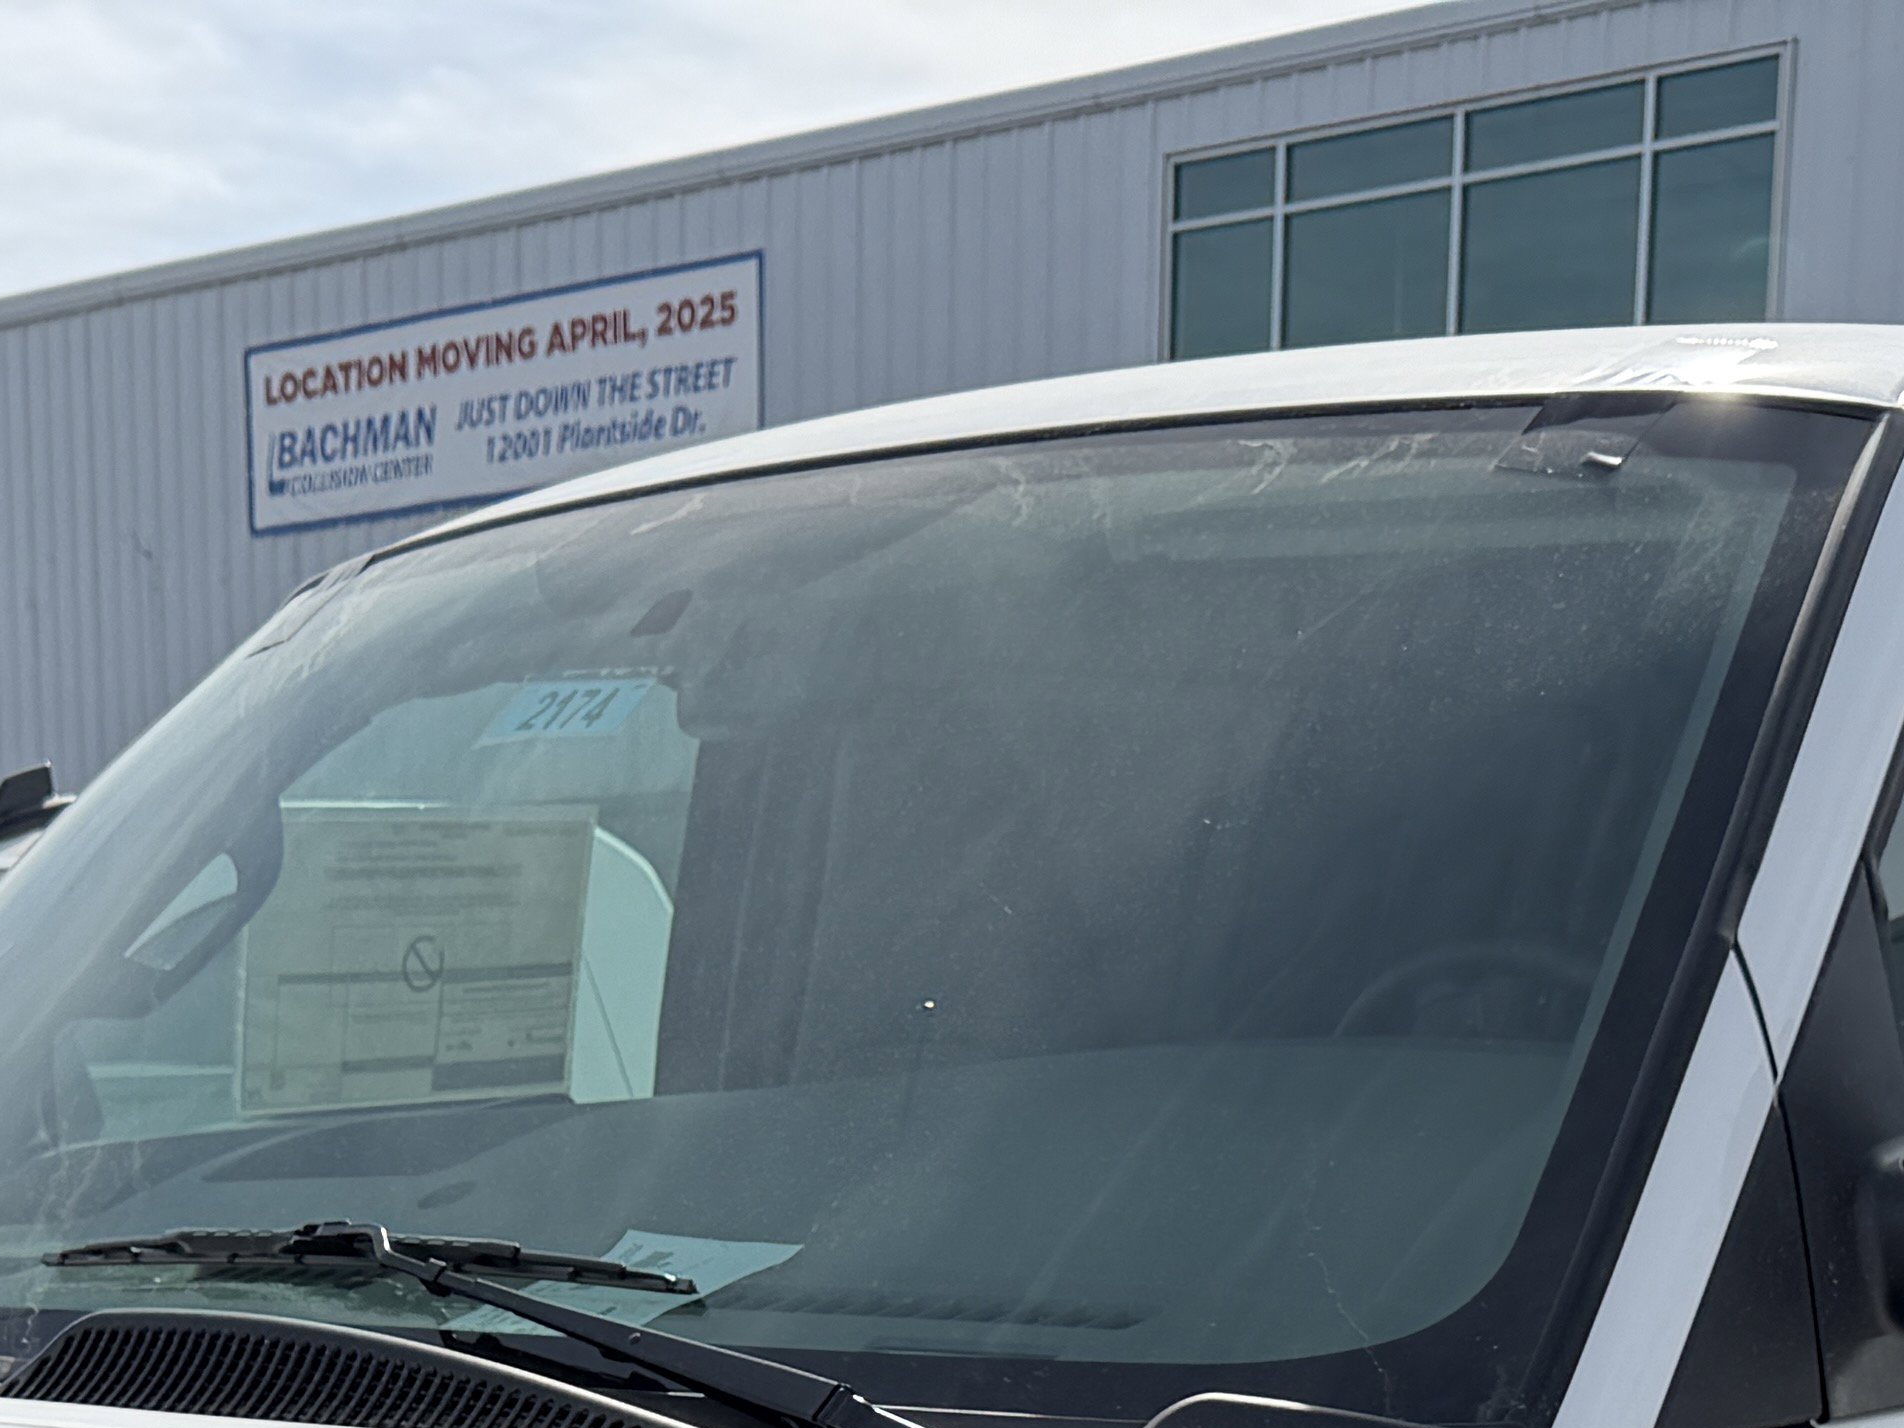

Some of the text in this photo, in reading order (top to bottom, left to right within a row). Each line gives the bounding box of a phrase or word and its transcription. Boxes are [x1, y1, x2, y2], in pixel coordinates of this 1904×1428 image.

[265, 290, 738, 406] LOCATION MOVING APRIL, 2025
[454, 356, 738, 432] JUST DOWN THE STREET
[277, 403, 437, 470] BACHMAN
[486, 403, 707, 464] 12001 Plantside Dr.
[370, 453, 434, 484] CENTER
